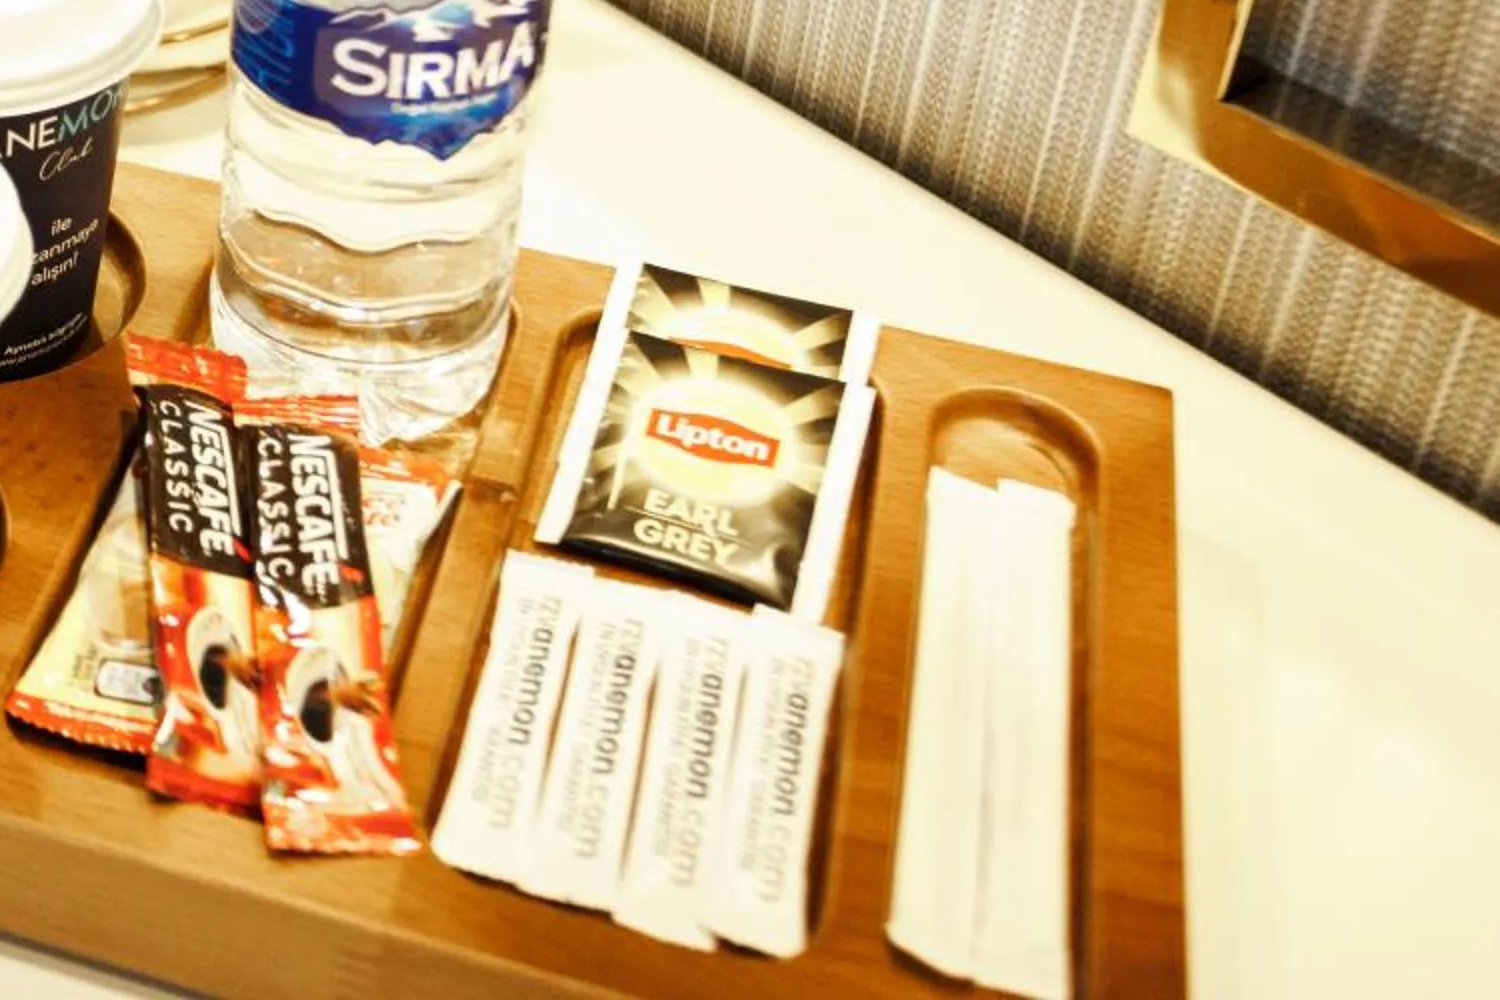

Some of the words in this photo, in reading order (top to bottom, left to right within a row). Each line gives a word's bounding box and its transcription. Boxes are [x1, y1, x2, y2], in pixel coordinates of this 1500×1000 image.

[32, 218, 100, 266] zanmaya
[51, 216, 74, 237] ile
[656, 413, 770, 461] Lipton
[160, 401, 194, 533] CLASSIC
[258, 437, 296, 580] CLASSIC
[643, 486, 739, 537] EARL
[633, 518, 740, 566] GREY
